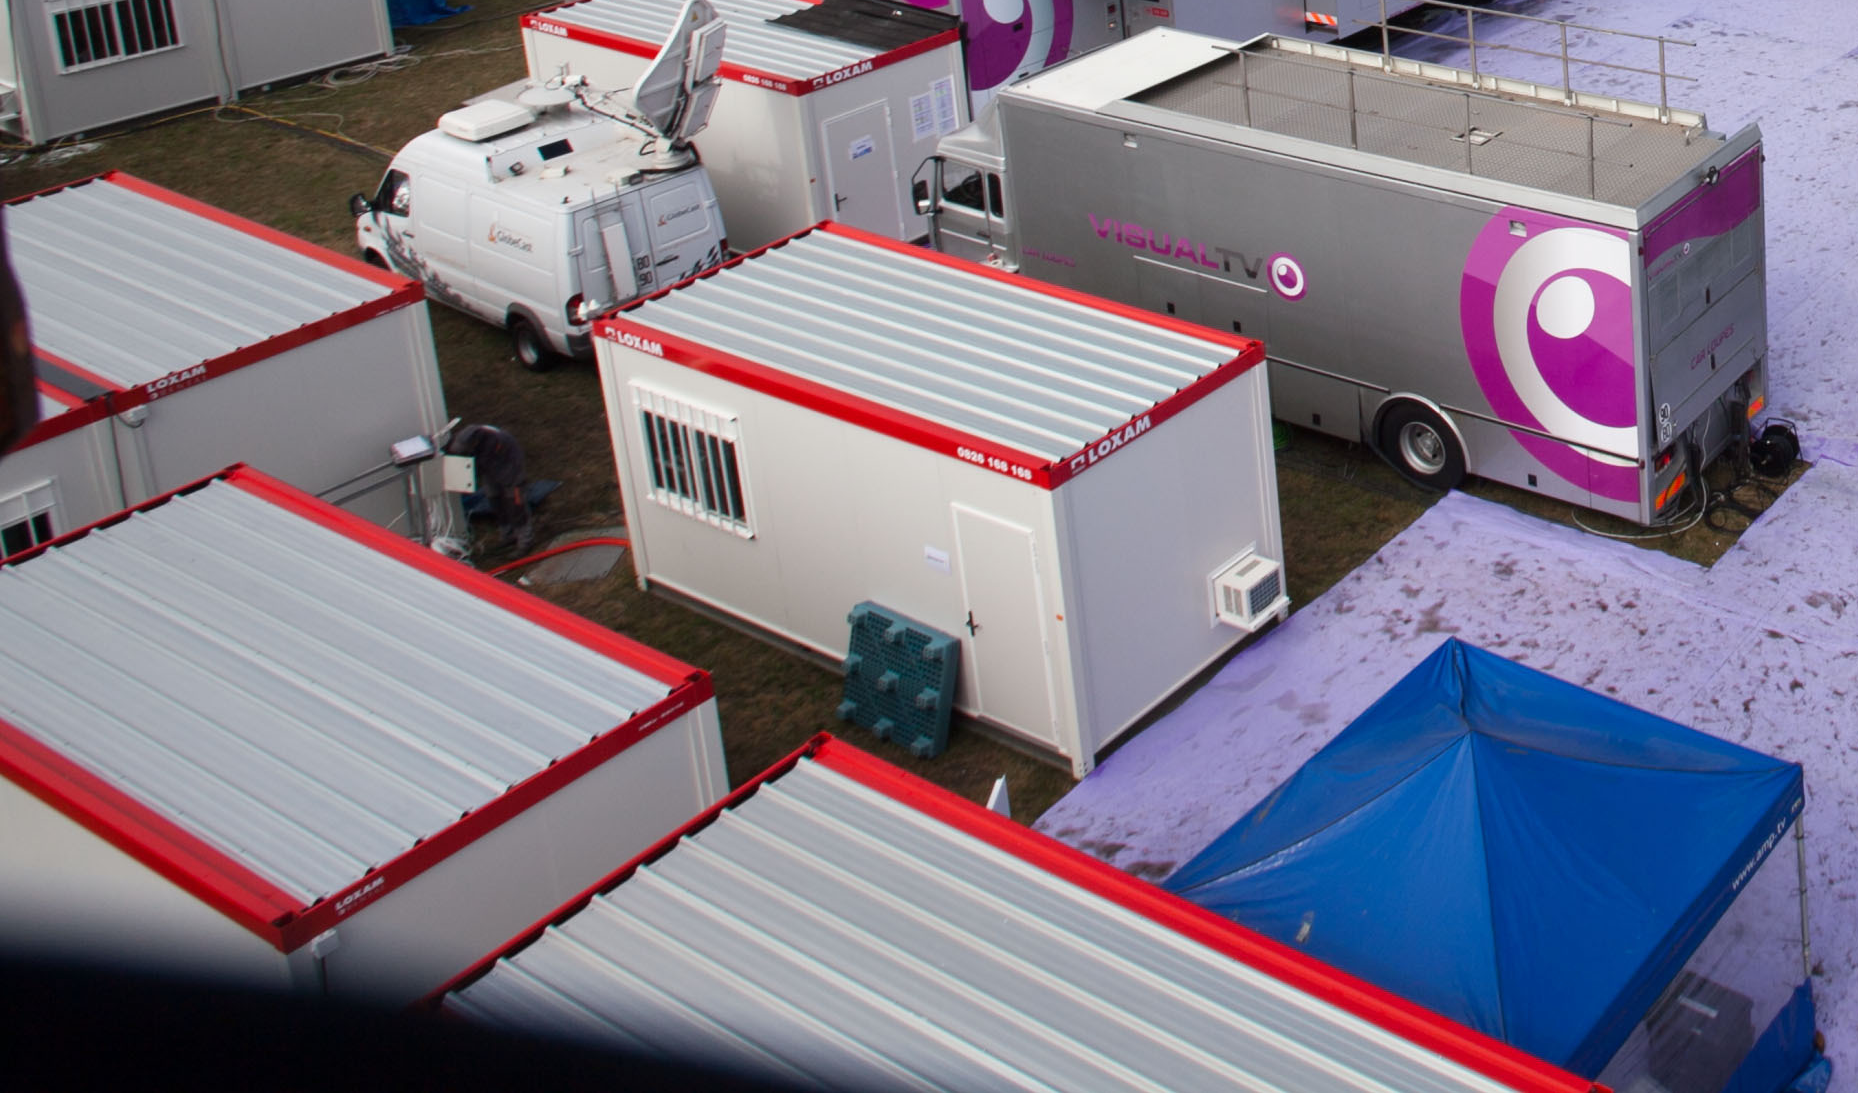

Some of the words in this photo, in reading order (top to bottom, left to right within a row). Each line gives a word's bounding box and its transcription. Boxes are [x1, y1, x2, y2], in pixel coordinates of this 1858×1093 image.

[538, 22, 568, 38] LOXAM
[826, 61, 874, 85] LOXAM
[1088, 212, 1264, 280] VISUALTV
[636, 256, 650, 271] 80
[638, 272, 653, 286] 90
[616, 330, 664, 356] LOXAM
[146, 364, 206, 393] LOXAM
[1086, 415, 1151, 465] LOXAM
[956, 446, 985, 465] 0826
[988, 455, 1008, 473] 168
[1011, 463, 1032, 480] 168
